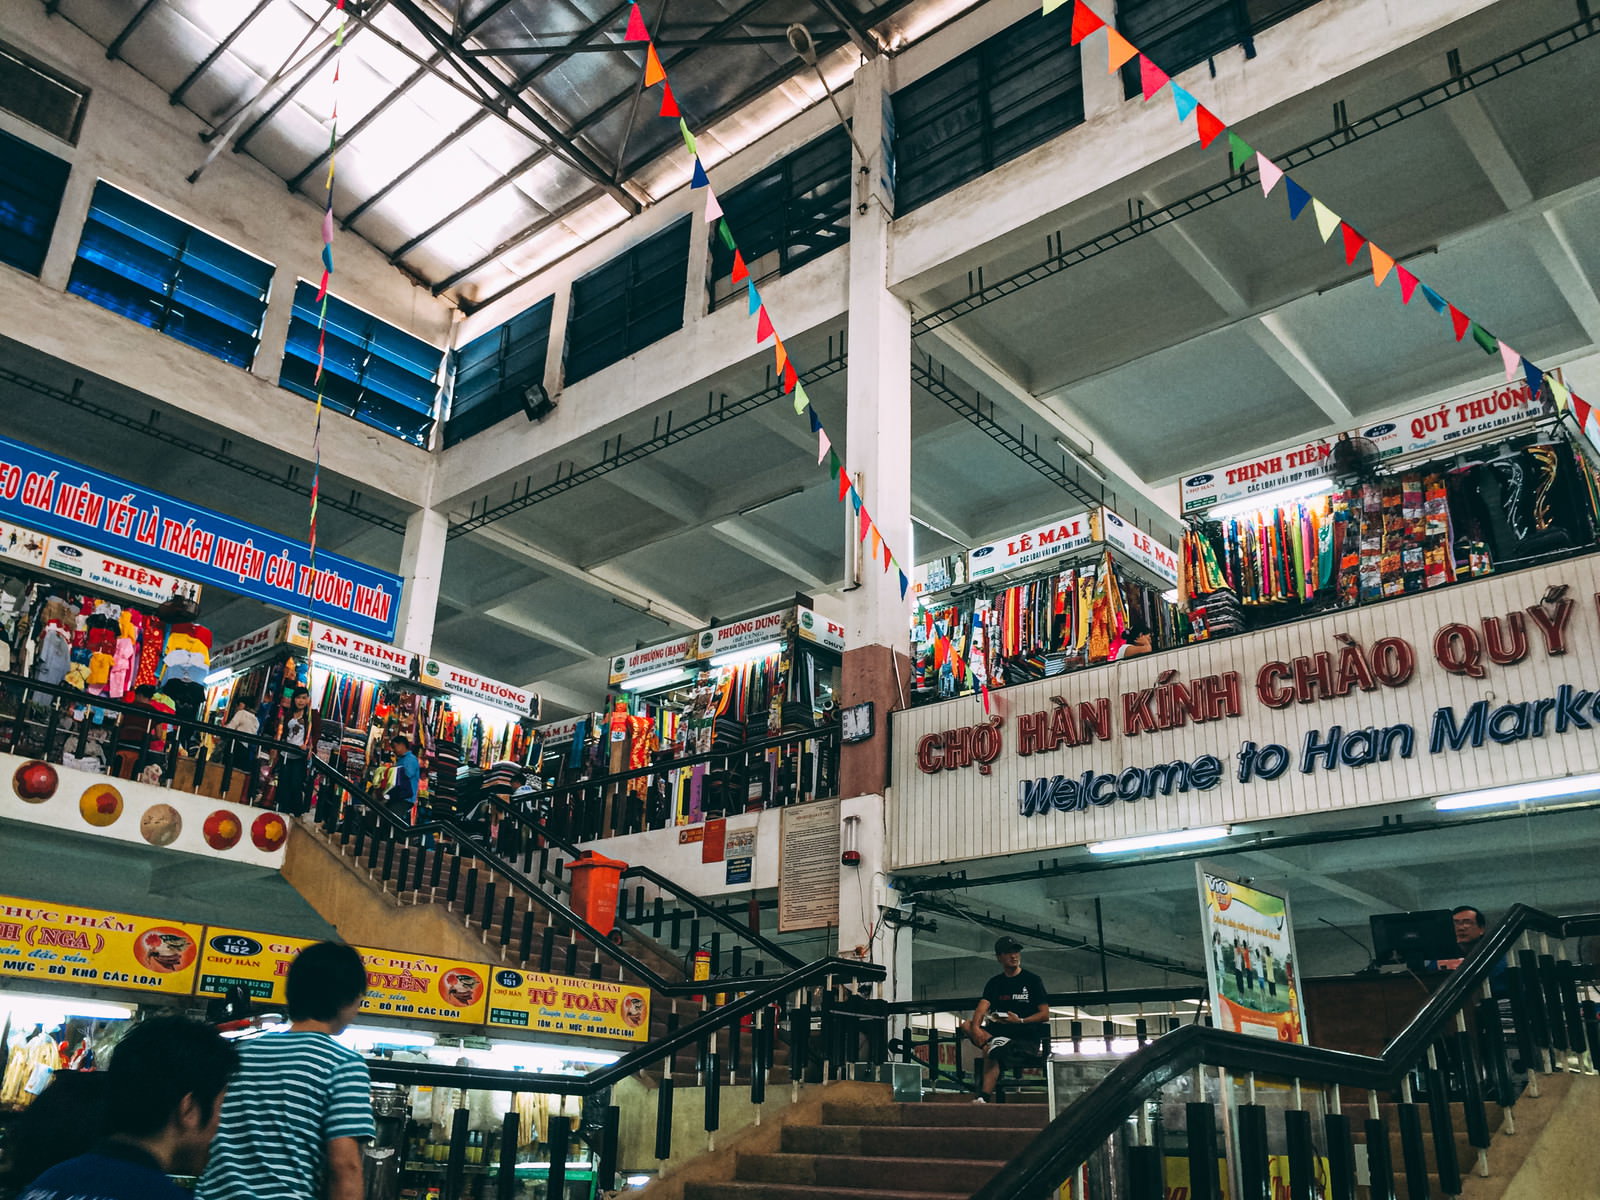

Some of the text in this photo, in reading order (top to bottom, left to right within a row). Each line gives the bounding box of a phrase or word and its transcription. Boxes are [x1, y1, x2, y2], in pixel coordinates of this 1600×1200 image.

[1410, 404, 1450, 439] QUÝ
[1477, 421, 1492, 431] CÁC
[1225, 456, 1283, 485] THỊNH
[1286, 443, 1331, 468] TIÊN
[1247, 483, 1260, 493] CÁC
[1261, 480, 1276, 490] LOẠI
[21, 470, 60, 513] GIÁ
[53, 481, 105, 528] NIÊM
[103, 493, 139, 538] YẾT
[134, 505, 160, 547] LÀ
[160, 517, 215, 565] TRÁCH
[212, 537, 266, 583] NHIỆM
[264, 548, 296, 592] CỦA
[352, 584, 392, 623] NHÂN
[1007, 534, 1033, 556] LÊ
[1038, 521, 1081, 546] MAI
[1020, 556, 1030, 564] CÁC
[1133, 532, 1152, 555] LÊ
[1154, 547, 1178, 571] MA
[102, 559, 163, 588] THIỆN
[718, 614, 781, 640] PHƯƠNG DUNG
[320, 629, 349, 647] ÂN
[353, 640, 407, 665] TRÌNH
[823, 639, 844, 651] CHUY
[450, 672, 526, 704] THƯ HƯƠNG
[917, 713, 1002, 775] CHỢ
[1016, 695, 1111, 756] HÀN
[1121, 669, 1242, 737] KÍNH
[1256, 632, 1415, 709] CHÀO
[1434, 583, 1574, 679] QUÝ
[1019, 754, 1223, 817] Welcome
[1237, 740, 1290, 783] to
[1299, 723, 1415, 774] Han
[0, 904, 136, 933] HỰC PHẨM
[28, 948, 58, 960] đặc
[223, 944, 250, 955] 152
[227, 937, 248, 946] LÔ
[3, 960, 36, 973] MỰC
[48, 964, 66, 975] BÒ
[72, 967, 98, 979] KHÔ
[103, 970, 129, 982] CÁC
[133, 975, 163, 987] LOẠI
[207, 955, 260, 967] CHỢ HÀN
[389, 959, 439, 973] PHẨM
[503, 978, 516, 986] 151
[526, 974, 546, 983] GIA
[561, 978, 590, 989] THỰC
[379, 1001, 392, 1011] BÒ
[395, 1004, 414, 1013] KHÔ
[417, 1006, 437, 1016] CÁC
[439, 1009, 460, 1019] LOẠI
[561, 989, 618, 1014] TOÀN
[537, 1019, 551, 1027] TÔM
